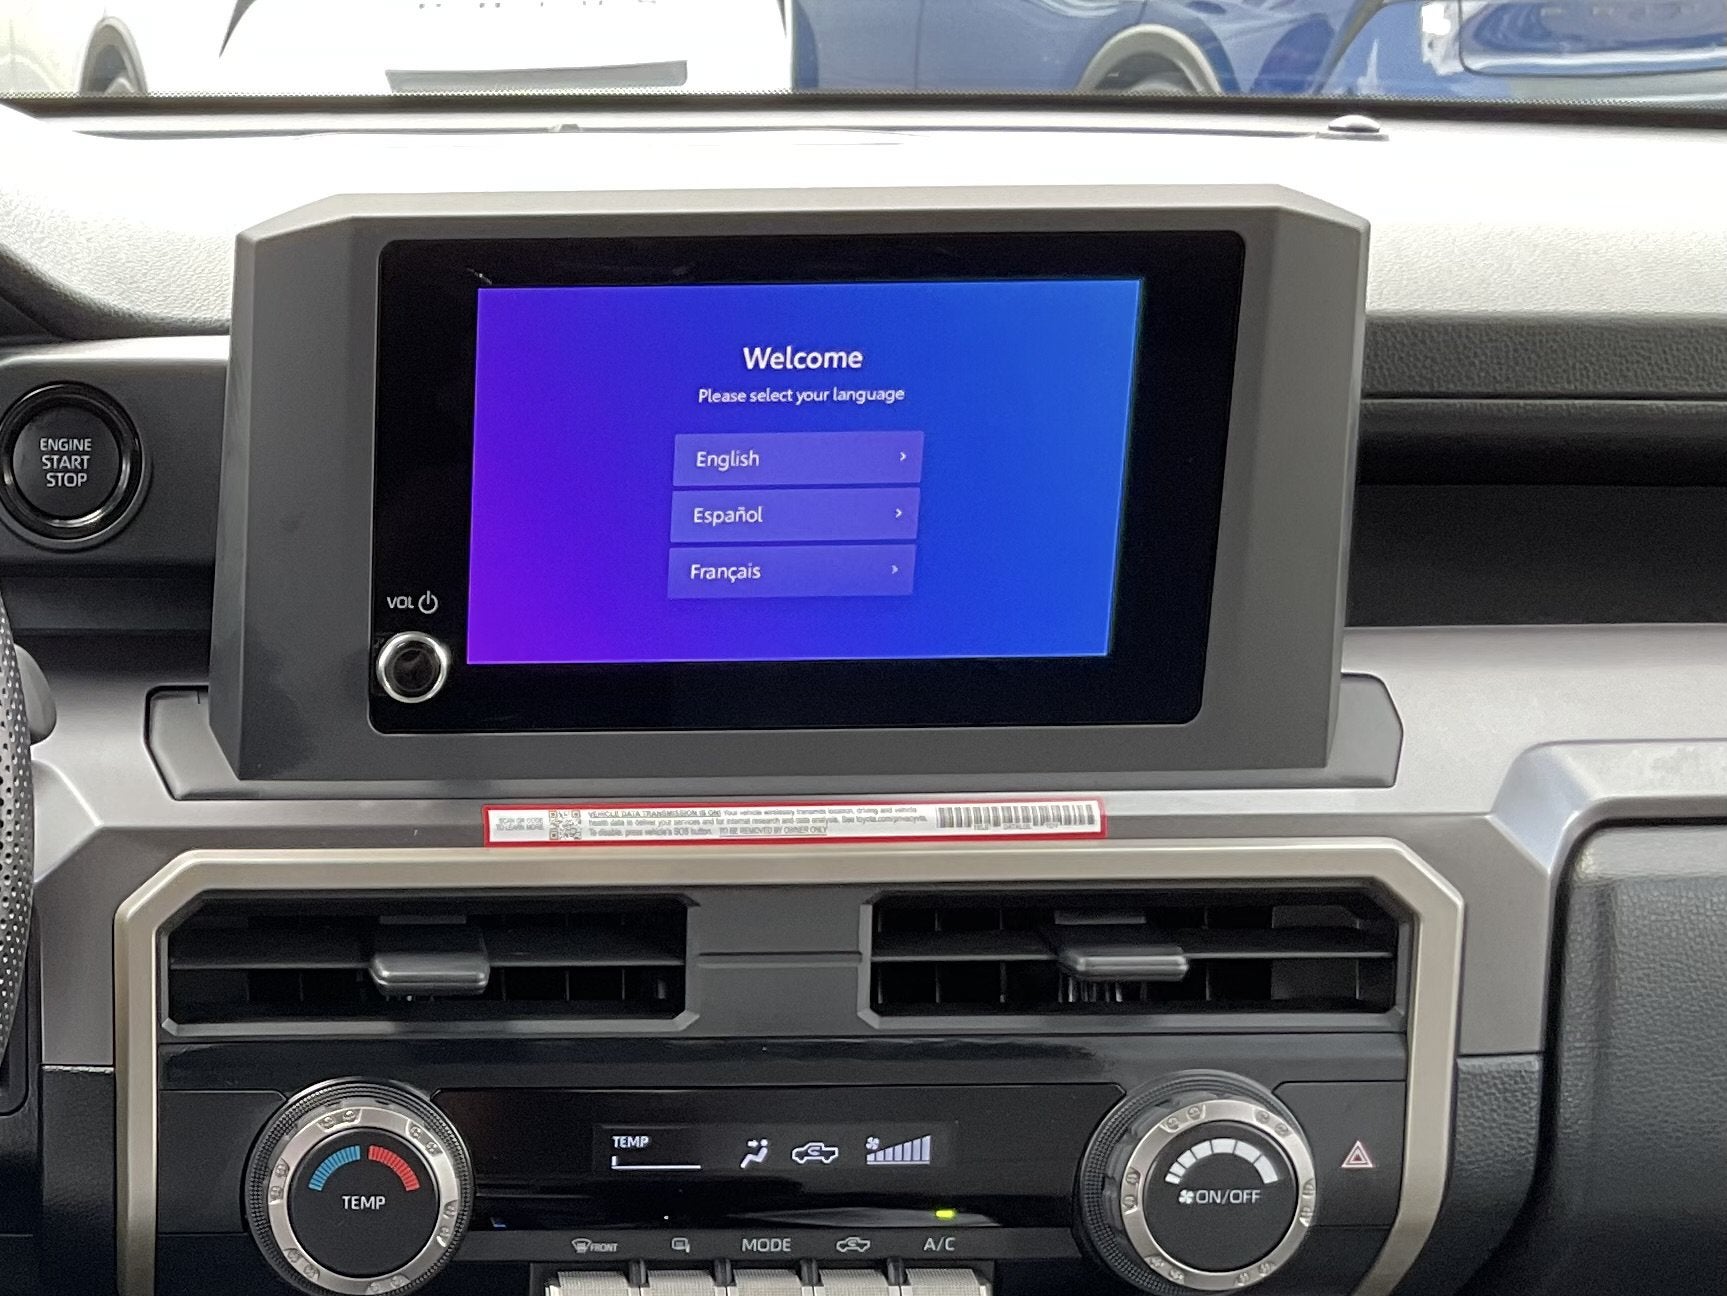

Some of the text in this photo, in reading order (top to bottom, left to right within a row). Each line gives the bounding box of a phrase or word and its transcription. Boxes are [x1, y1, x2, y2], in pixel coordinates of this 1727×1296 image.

[743, 345, 864, 370] Welcome
[698, 387, 905, 405] Please select your language
[40, 438, 92, 451] ENGINE
[41, 455, 90, 469] START
[696, 450, 760, 471] English
[46, 473, 87, 487] STOP
[693, 506, 763, 527] Español
[690, 562, 761, 584] Français
[387, 596, 415, 609] VOL
[612, 1135, 650, 1149] TEMP
[341, 1195, 386, 1210] TEMP
[1195, 1189, 1261, 1204] ON/OFF
[590, 1243, 619, 1253] FRONT
[741, 1238, 792, 1252] MODE
[923, 1236, 956, 1251] A/C
